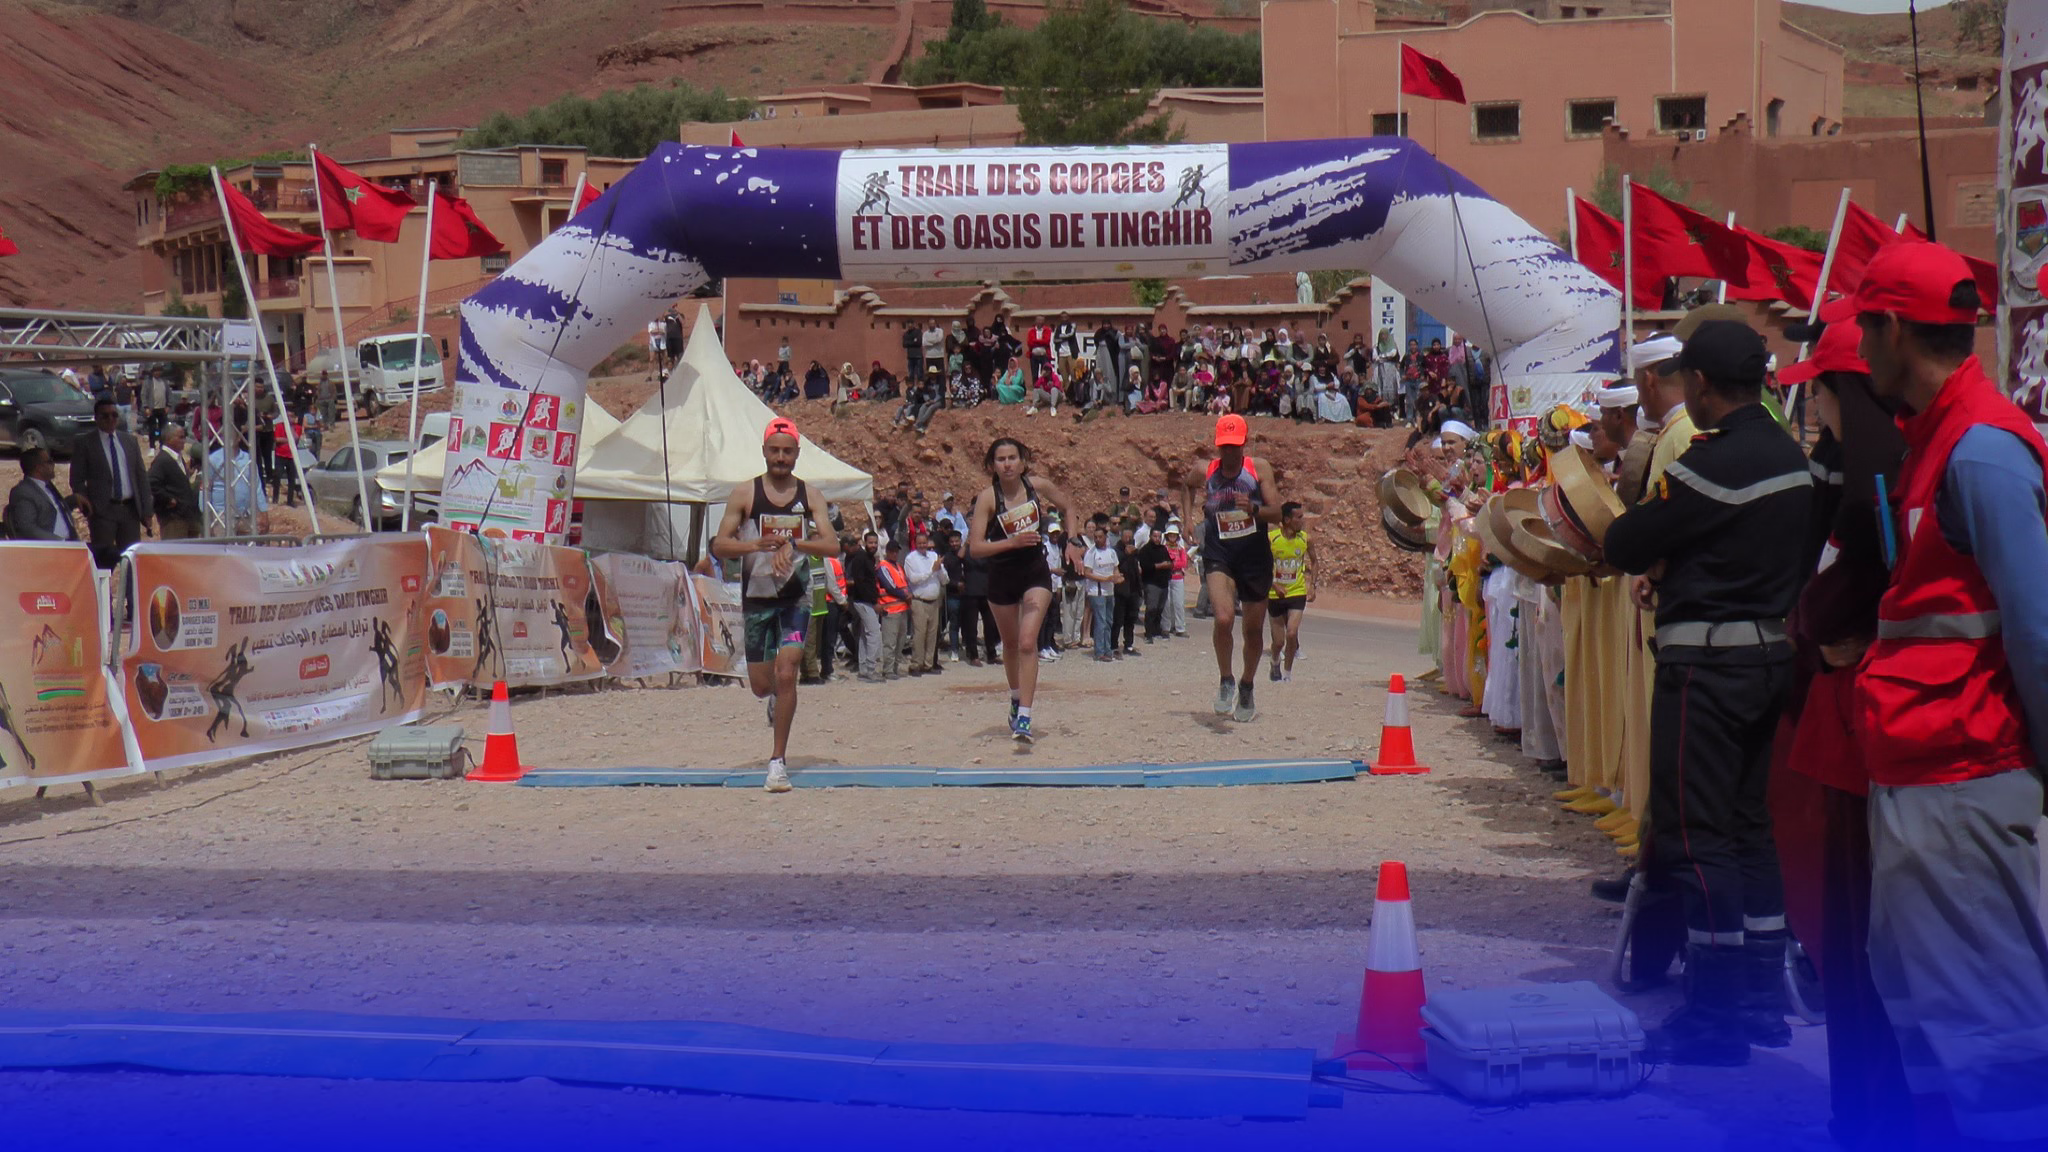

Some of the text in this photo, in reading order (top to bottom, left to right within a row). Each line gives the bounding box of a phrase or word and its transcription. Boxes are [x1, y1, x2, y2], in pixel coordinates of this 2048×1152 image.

[898, 161, 1165, 197] TRAIL DES GORGES
[852, 208, 1212, 251] ET DES OASIS DE TINGHIR
[772, 528, 793, 538] 246
[1014, 515, 1033, 531] 244
[1228, 520, 1246, 531] 251
[229, 606, 257, 625] TRAIL
[260, 604, 278, 623] DES
[356, 588, 389, 609] TINGHIR
[275, 627, 311, 649] الواحات
[320, 623, 348, 645] المضايق
[350, 618, 369, 639] ترايل
